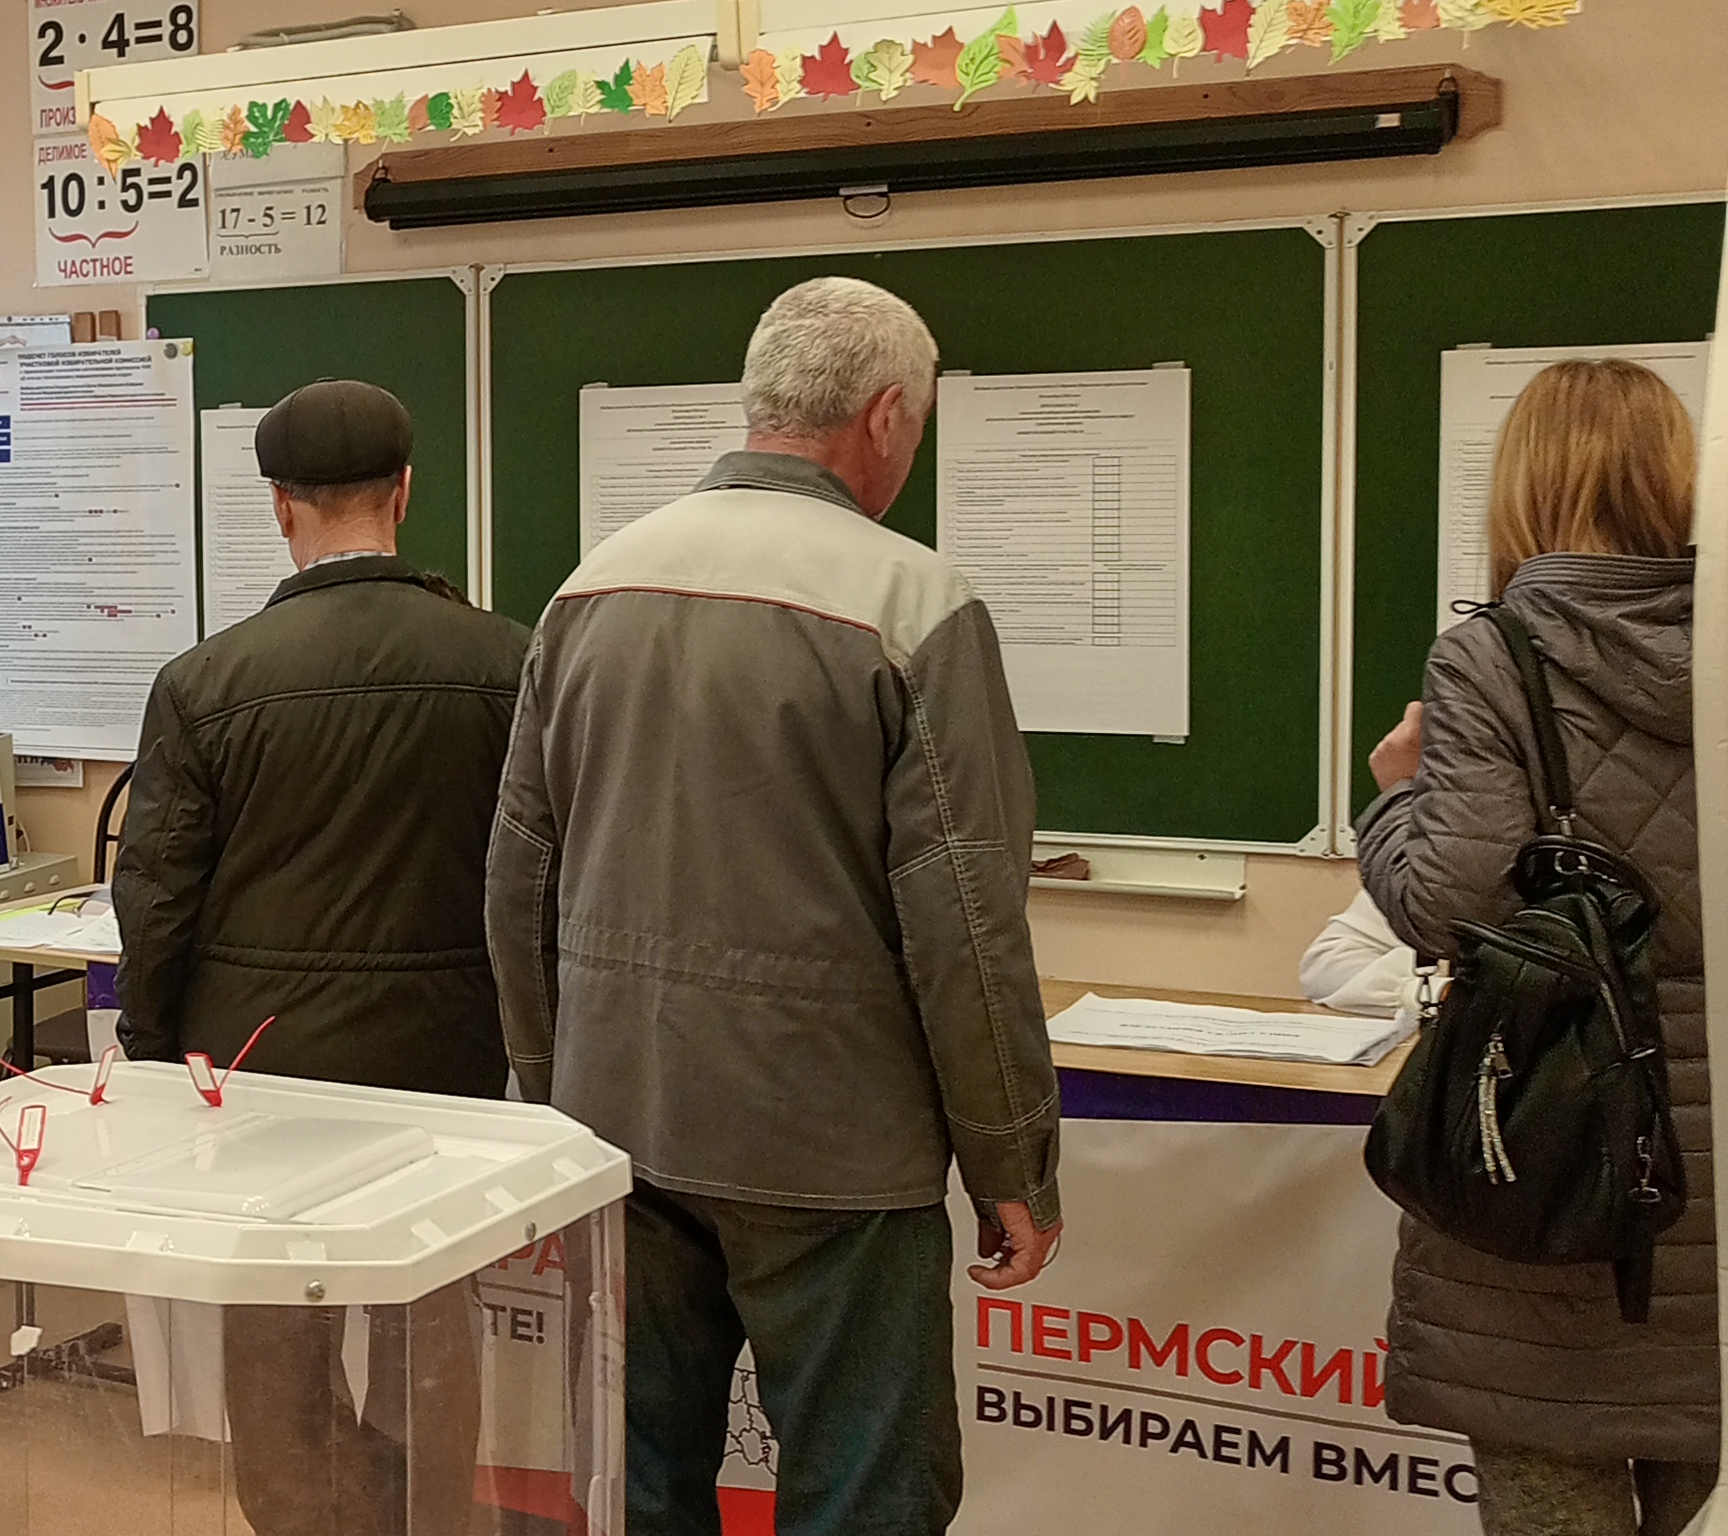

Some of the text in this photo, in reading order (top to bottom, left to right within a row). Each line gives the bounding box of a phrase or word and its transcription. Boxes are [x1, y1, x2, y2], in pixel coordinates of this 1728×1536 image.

[38, 143, 87, 165] ДЕЛИМОЕ
[219, 207, 241, 230] 17
[262, 206, 275, 228] 5
[303, 204, 328, 226] 12
[219, 244, 283, 256] РАЗНОСТЬ
[58, 256, 134, 279] ЧАСТНОЕ
[975, 1385, 1479, 1503] ВЫБИРАЕМ ВМЕС
